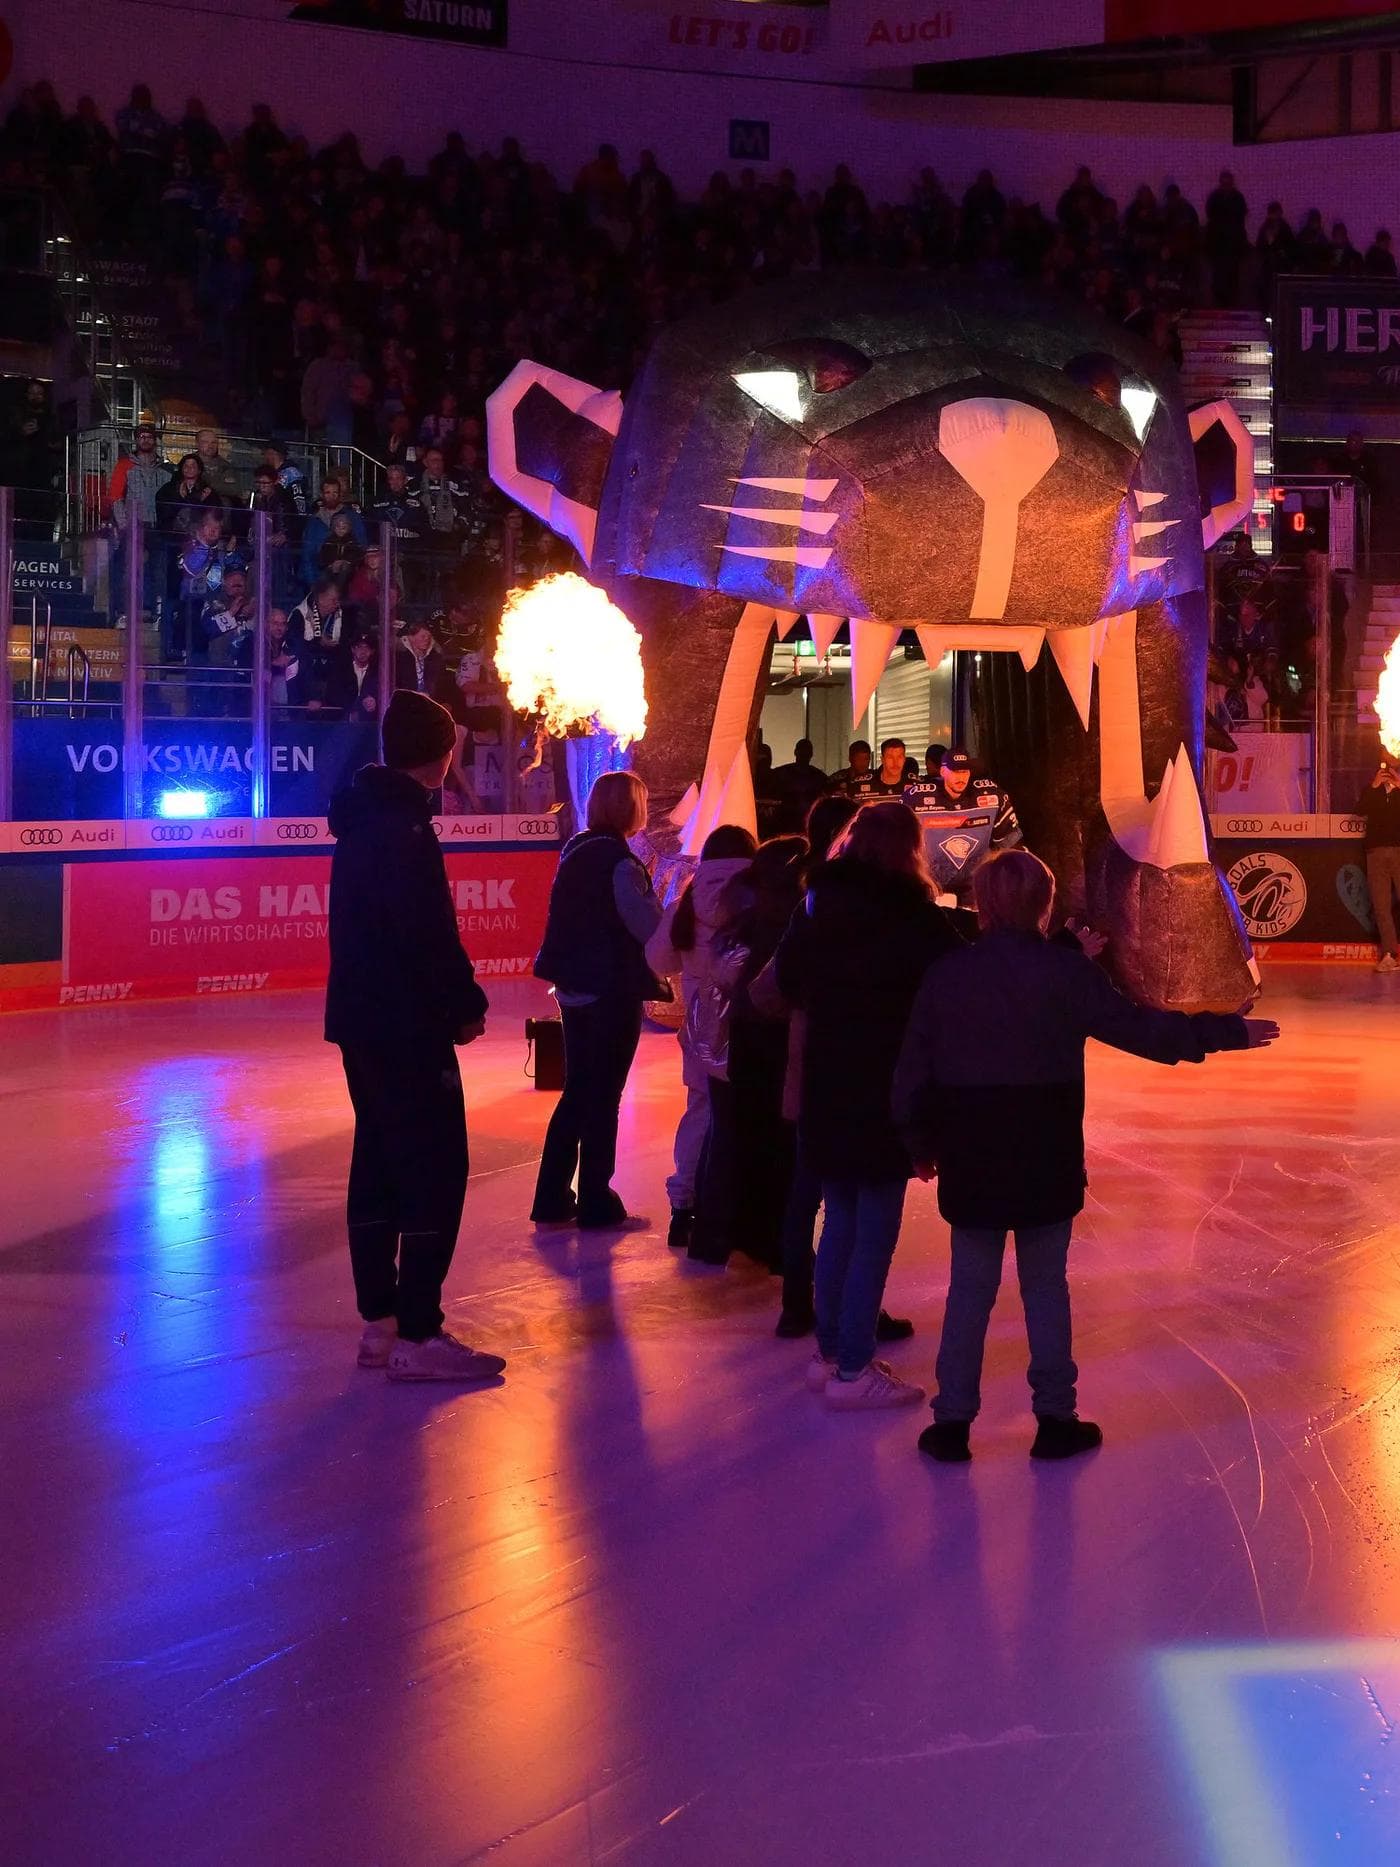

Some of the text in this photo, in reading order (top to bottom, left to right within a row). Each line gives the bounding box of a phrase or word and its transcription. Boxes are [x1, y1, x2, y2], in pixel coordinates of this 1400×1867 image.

[404, 0, 494, 31] SATURN
[669, 15, 816, 55] LET'S GO!
[866, 11, 953, 47] Audi
[14, 579, 73, 590] SERVICES
[200, 826, 244, 841] Audi
[450, 822, 493, 837] Audi
[1270, 819, 1309, 833] Audi
[70, 828, 116, 844] Audi
[149, 886, 242, 922] DAS
[1256, 918, 1287, 934] KIDS
[150, 927, 178, 946] DIE
[1322, 944, 1380, 961] PENN
[472, 956, 531, 975] ENNY
